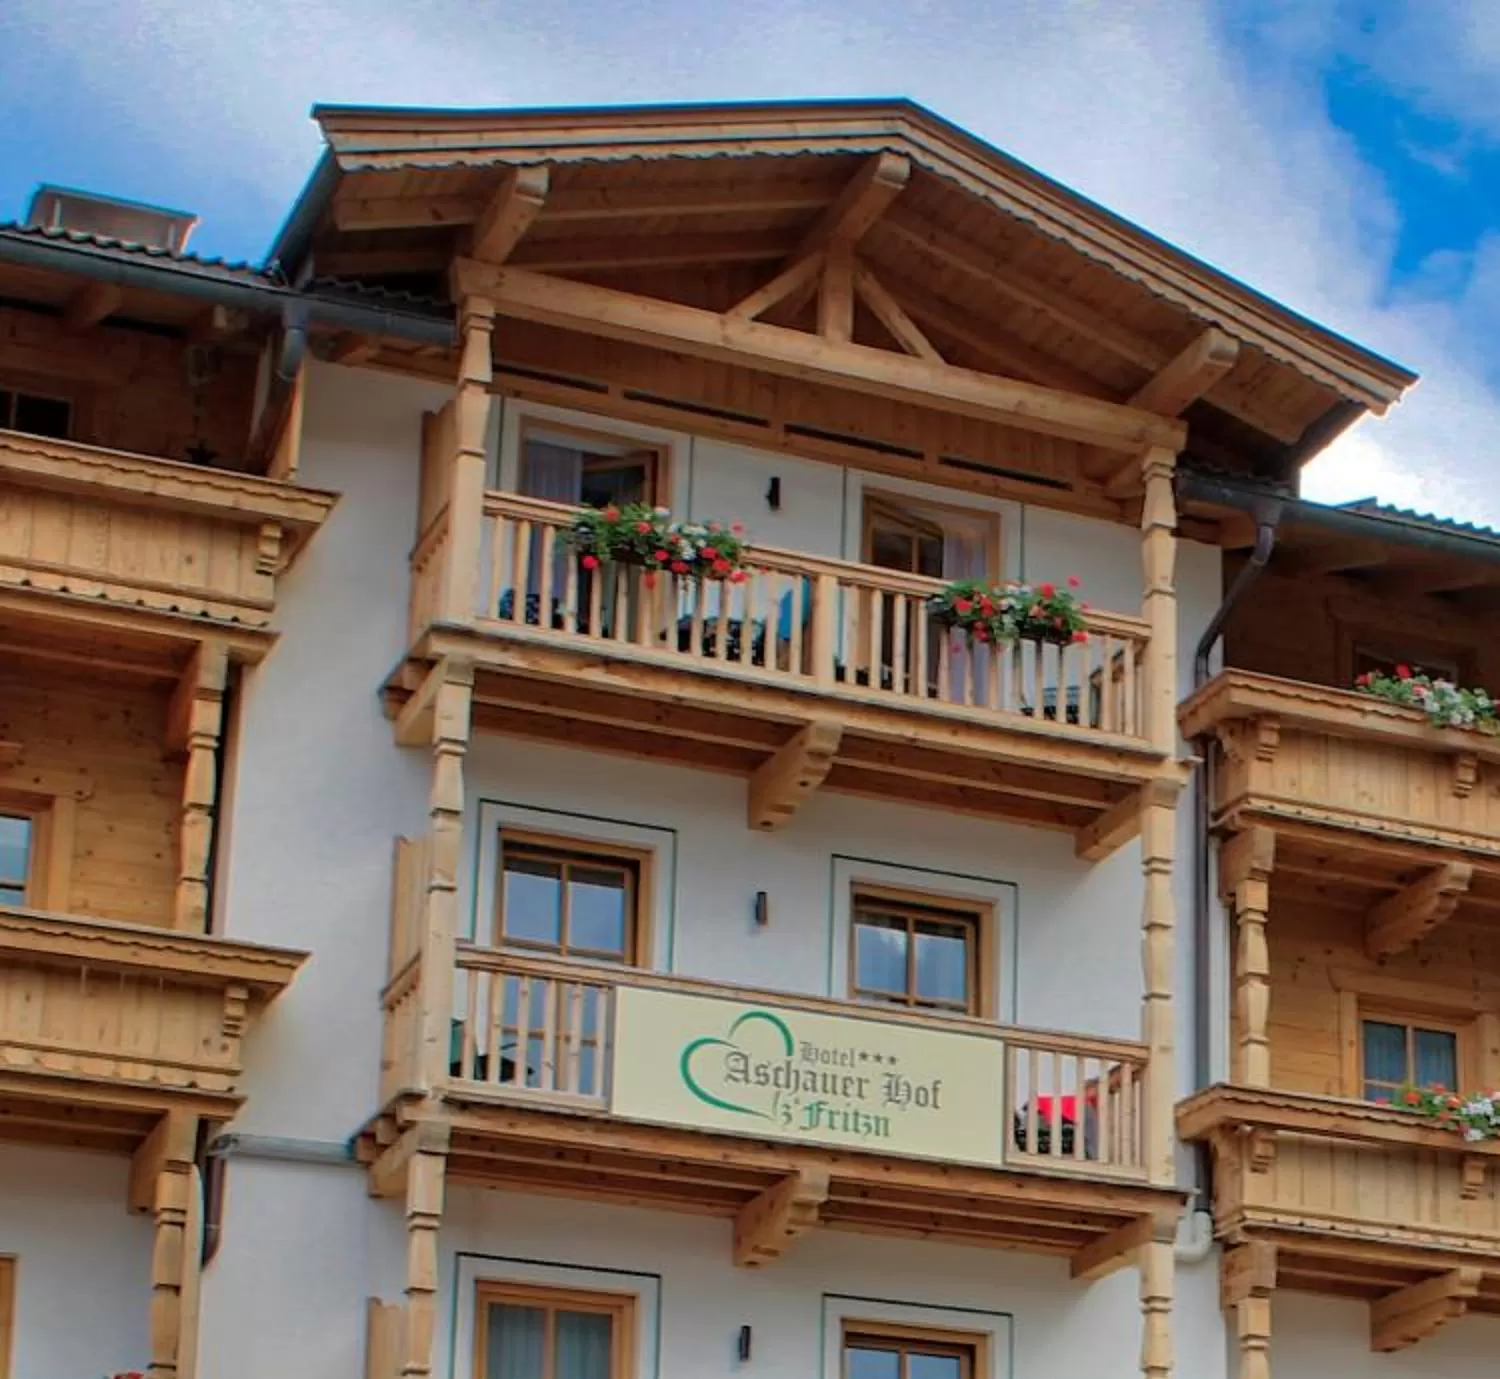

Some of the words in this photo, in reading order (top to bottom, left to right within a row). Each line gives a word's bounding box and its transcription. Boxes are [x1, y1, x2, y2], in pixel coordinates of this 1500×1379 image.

[799, 1041, 856, 1068] Hotel
[724, 1051, 870, 1101] Aschauer
[882, 1072, 943, 1111] Hof
